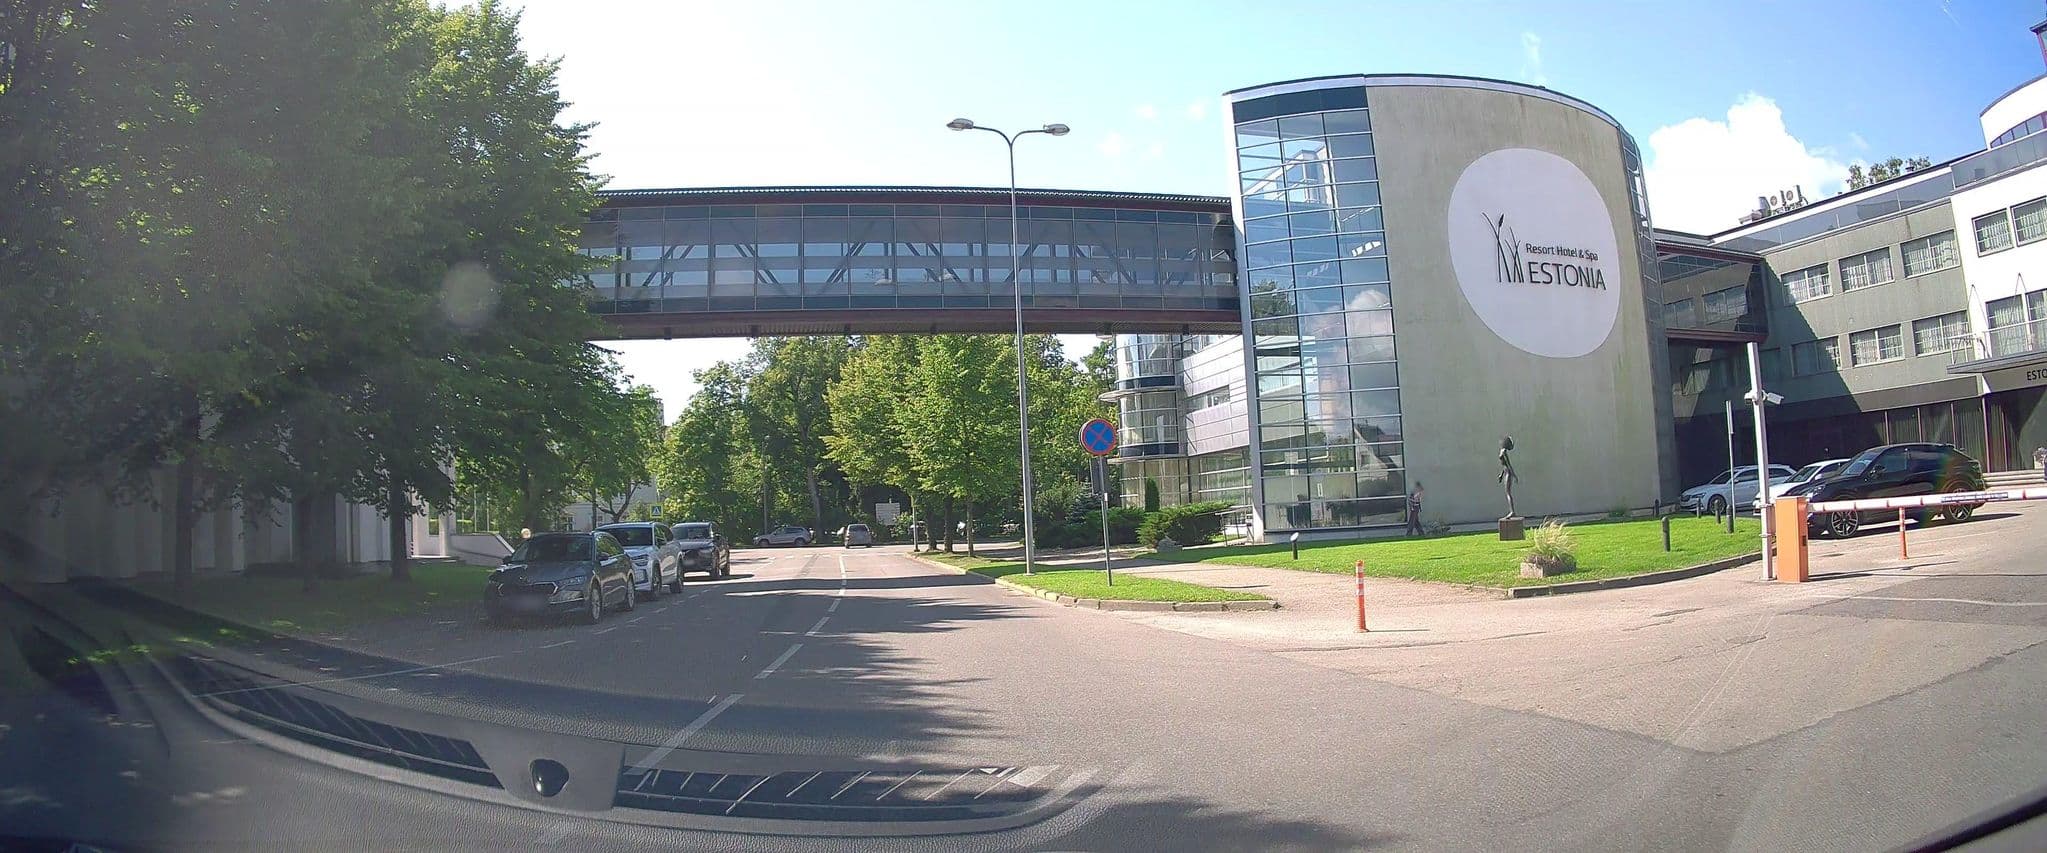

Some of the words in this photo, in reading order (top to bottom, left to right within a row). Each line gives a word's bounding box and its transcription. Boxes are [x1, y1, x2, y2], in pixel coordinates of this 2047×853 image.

[1526, 243, 1555, 255] Resort
[1557, 246, 1578, 258] Hotel
[1578, 249, 1585, 259] &
[1585, 249, 1599, 262] Spa
[1528, 261, 1606, 290] ESTONIA
